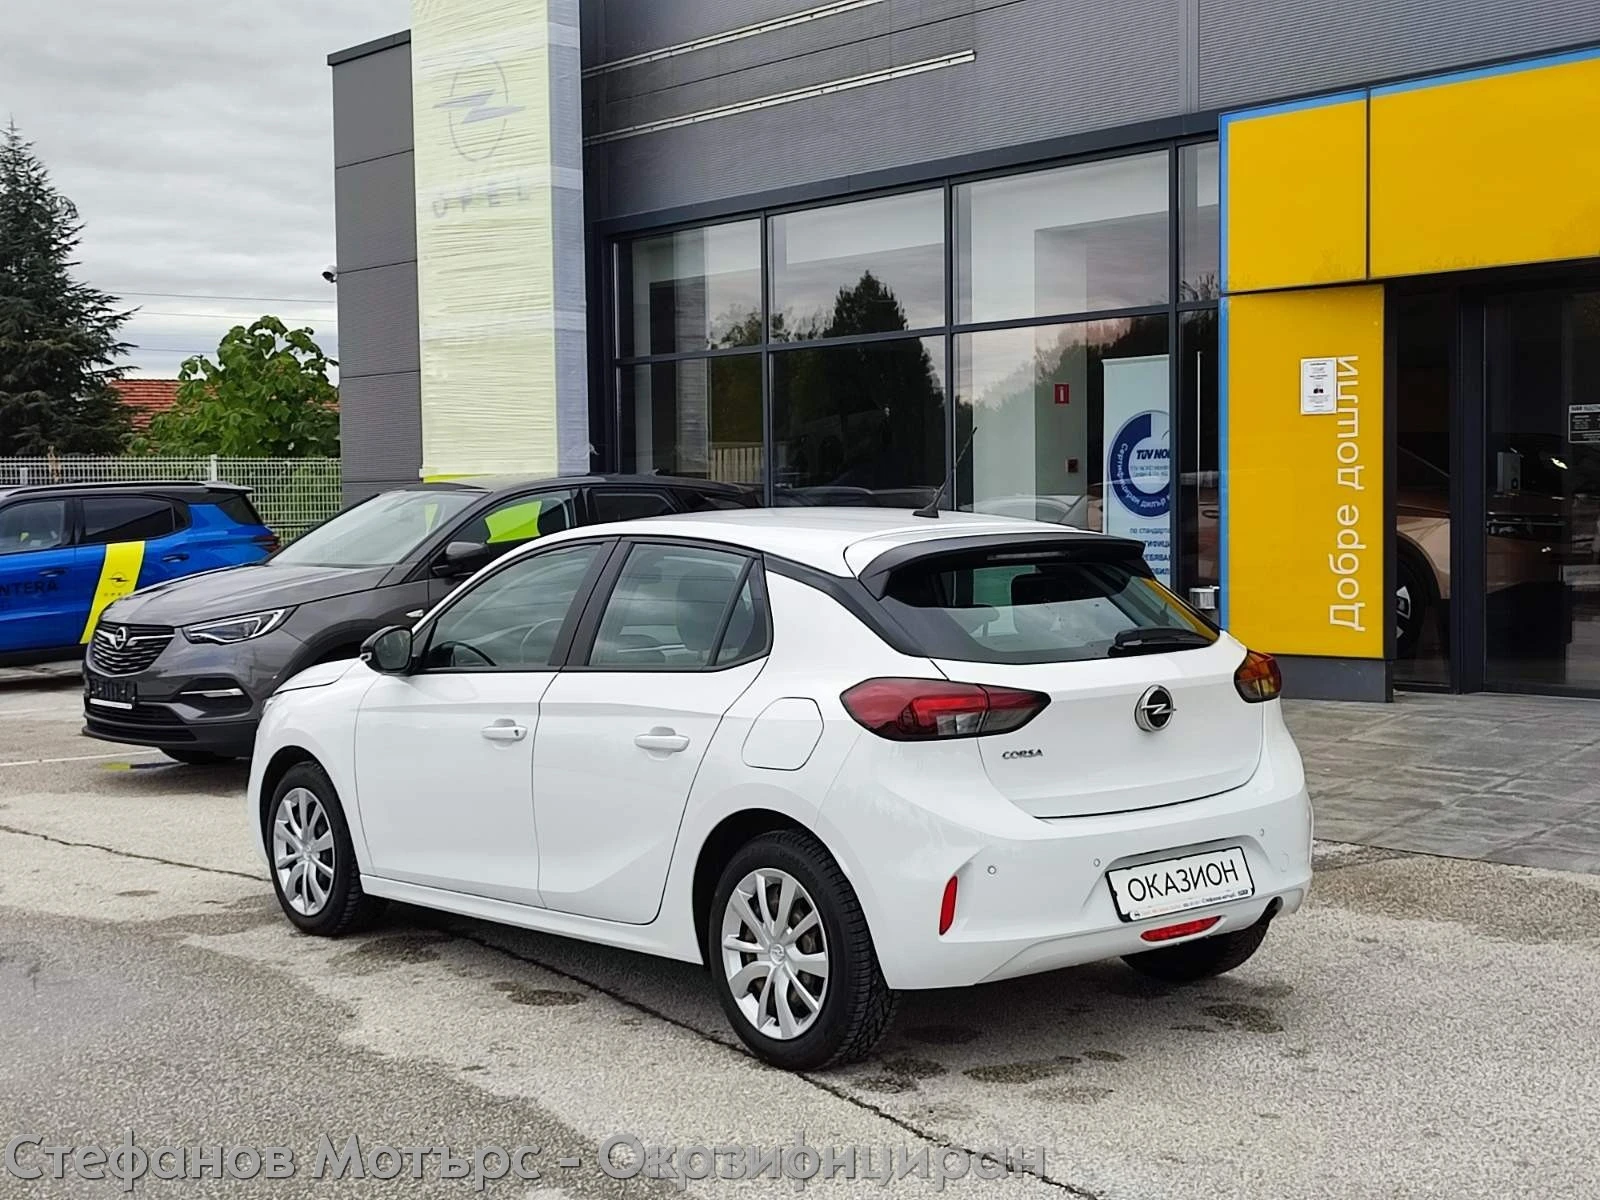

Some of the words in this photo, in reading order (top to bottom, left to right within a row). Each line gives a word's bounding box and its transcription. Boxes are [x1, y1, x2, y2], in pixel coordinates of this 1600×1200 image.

[1336, 355, 1365, 490] дошли
[1328, 504, 1367, 632] Добре
[1001, 748, 1044, 760] CORSA
[1127, 859, 1239, 902] ОКАЗИОН
